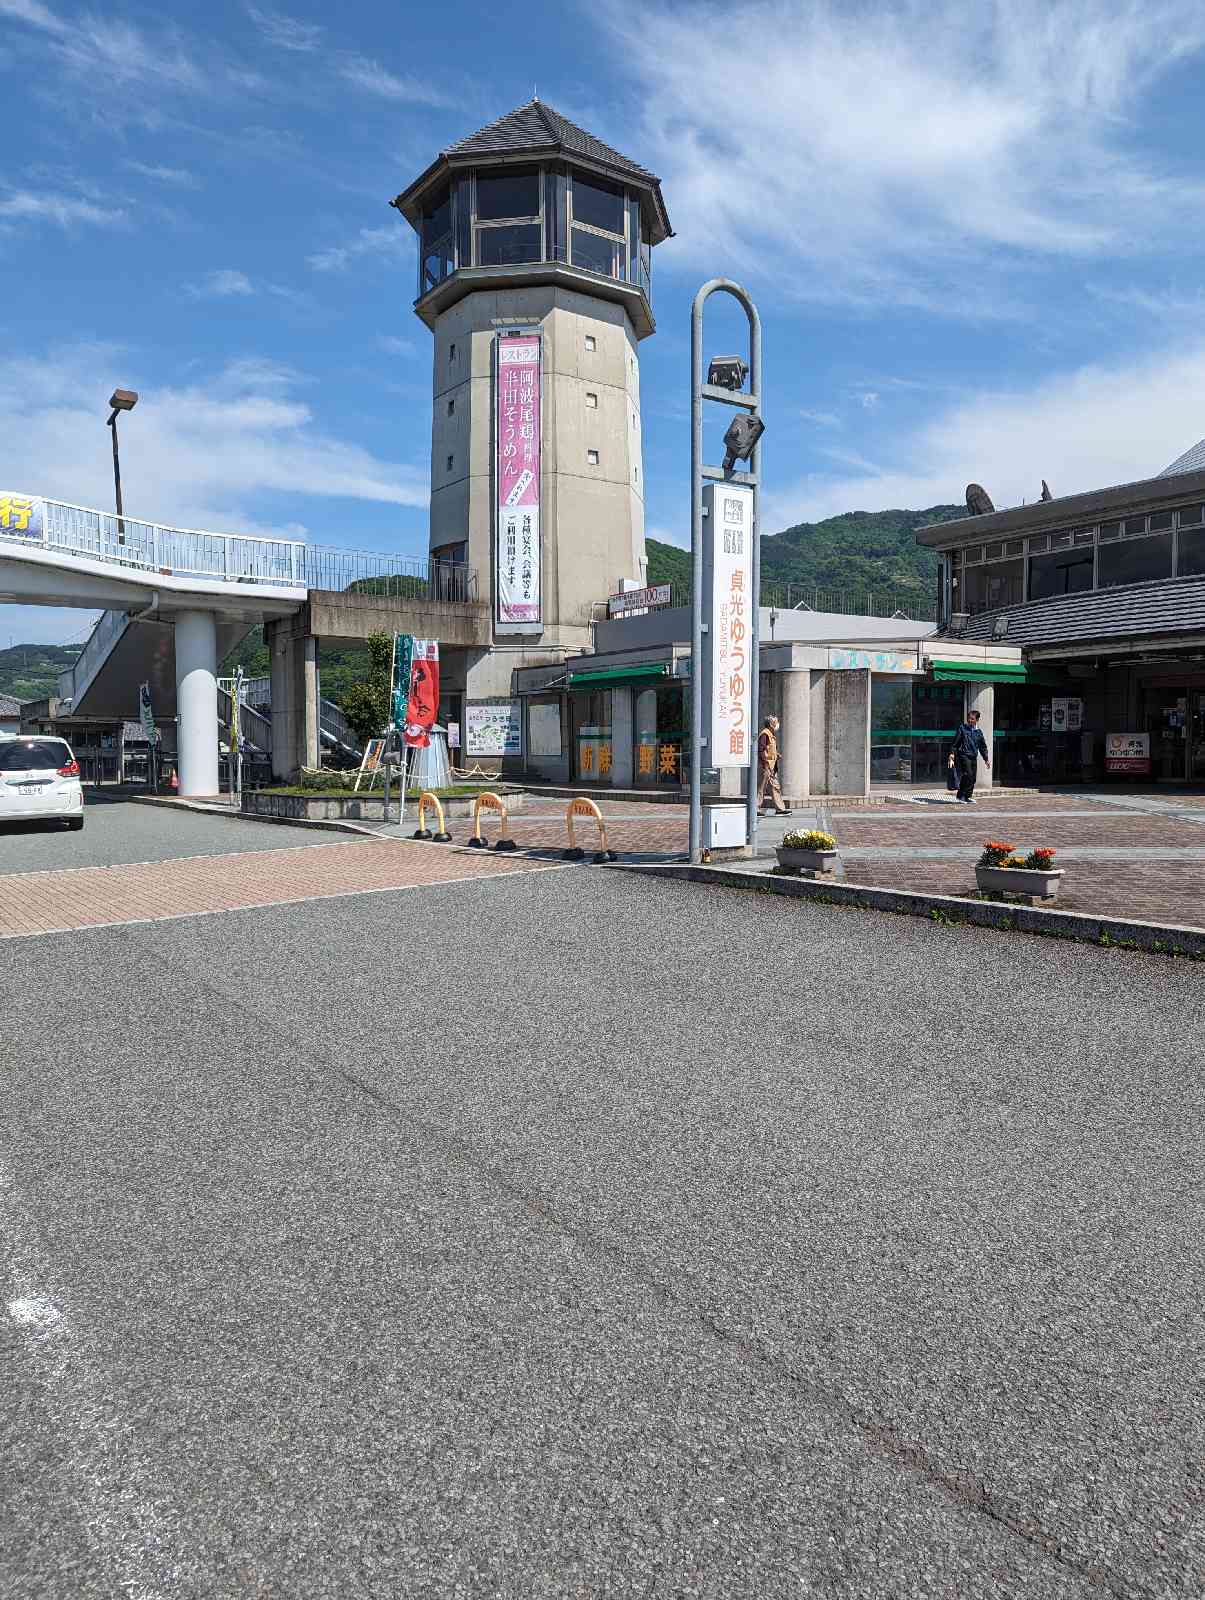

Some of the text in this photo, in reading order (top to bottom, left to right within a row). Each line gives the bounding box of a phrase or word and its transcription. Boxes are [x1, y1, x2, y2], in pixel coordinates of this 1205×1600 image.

[503, 370, 518, 475] 半田そうめん
[729, 568, 745, 755] 貞光ゆうゆう館
[638, 744, 676, 775] 野菜
